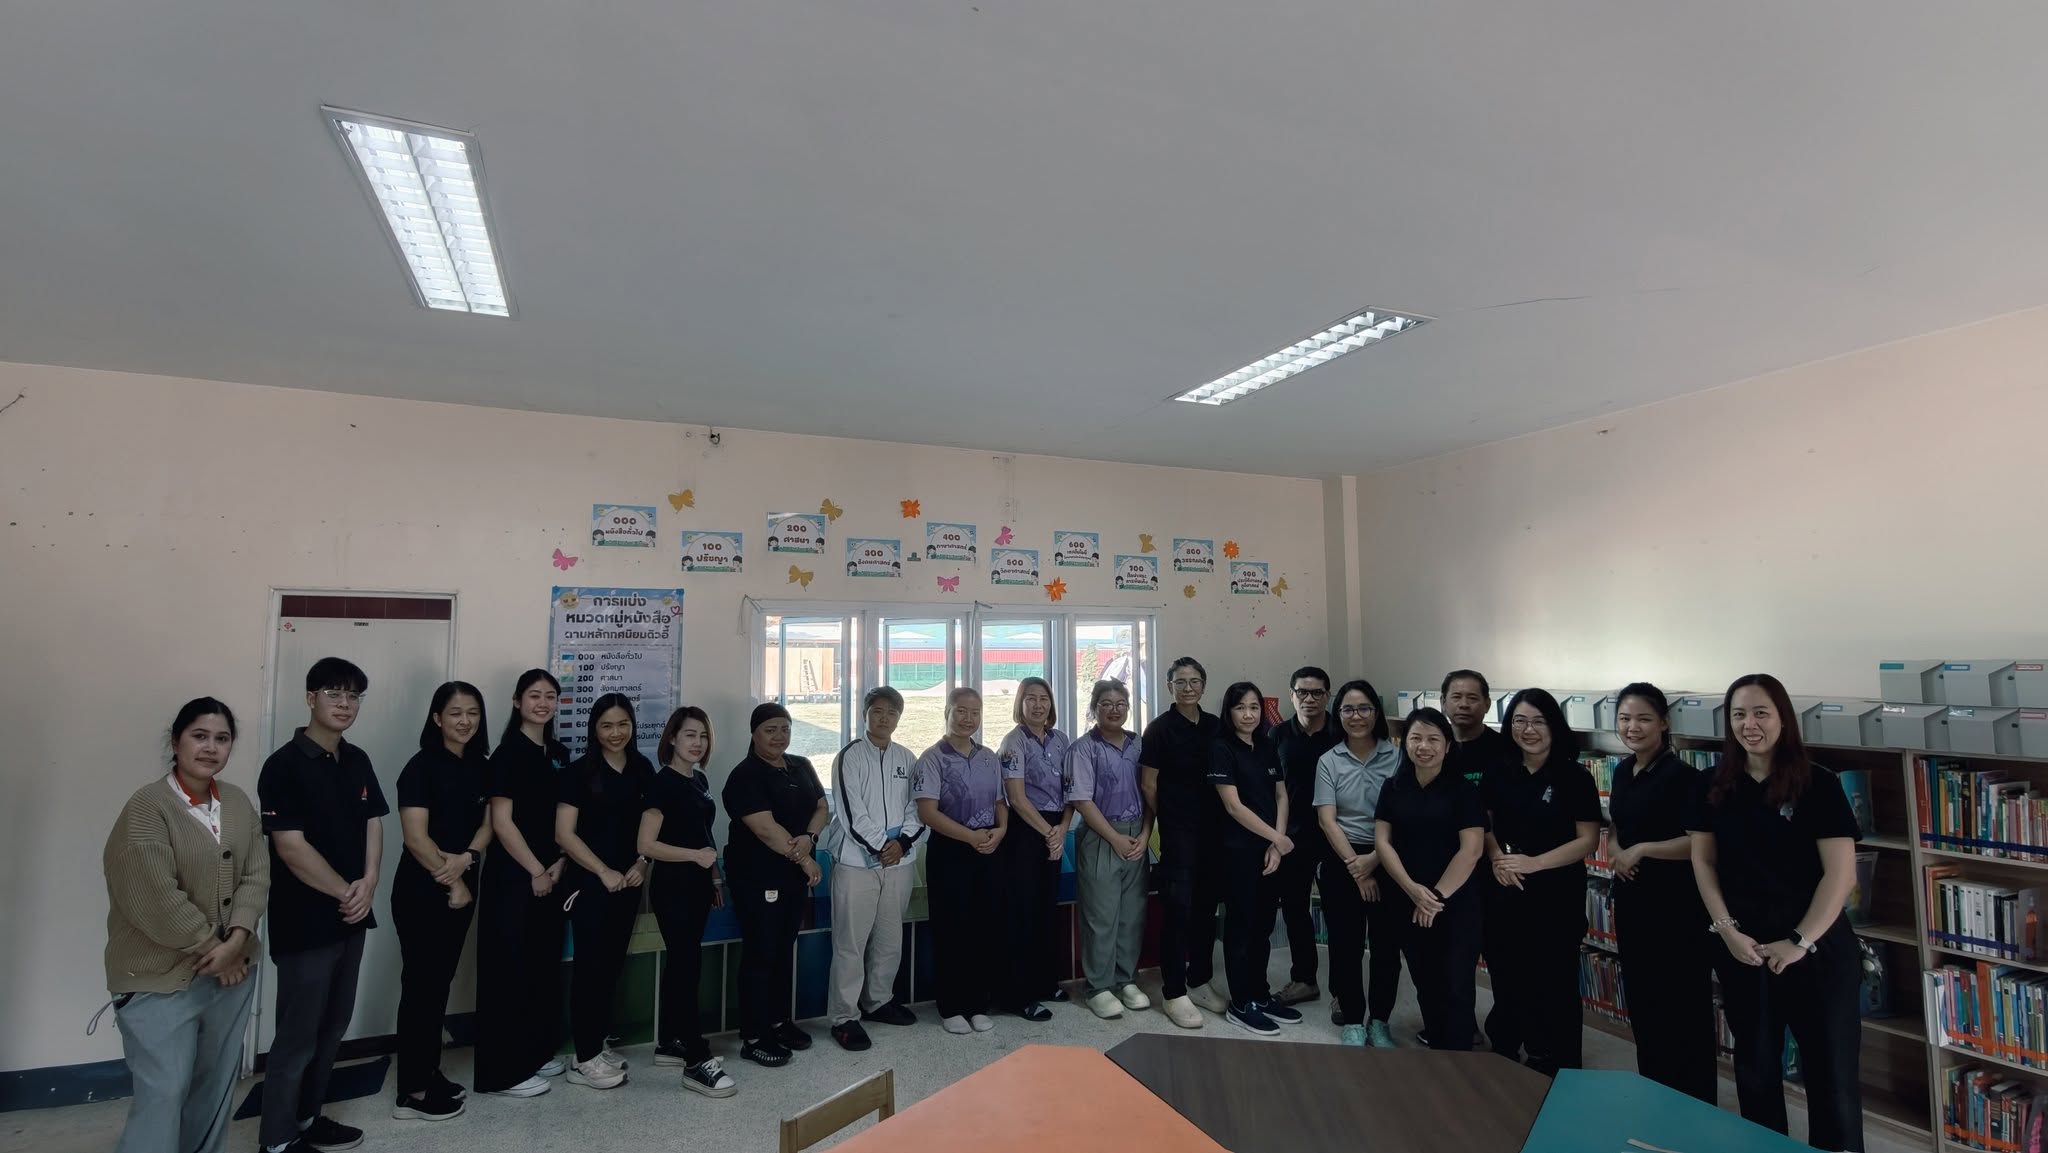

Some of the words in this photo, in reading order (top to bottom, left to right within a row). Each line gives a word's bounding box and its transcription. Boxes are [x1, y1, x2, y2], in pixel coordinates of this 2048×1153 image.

[613, 517, 636, 525] 000
[787, 524, 807, 532] 200
[783, 536, 810, 544] ศาสนา
[702, 542, 722, 551] 100
[696, 553, 729, 565] ปรัชญา
[592, 592, 647, 607] การแบ่ง
[565, 610, 671, 628] หมวดหมู่หนังสือ
[601, 650, 642, 660] หนังสือทั่วไป
[601, 662, 625, 671] ปรัชญา
